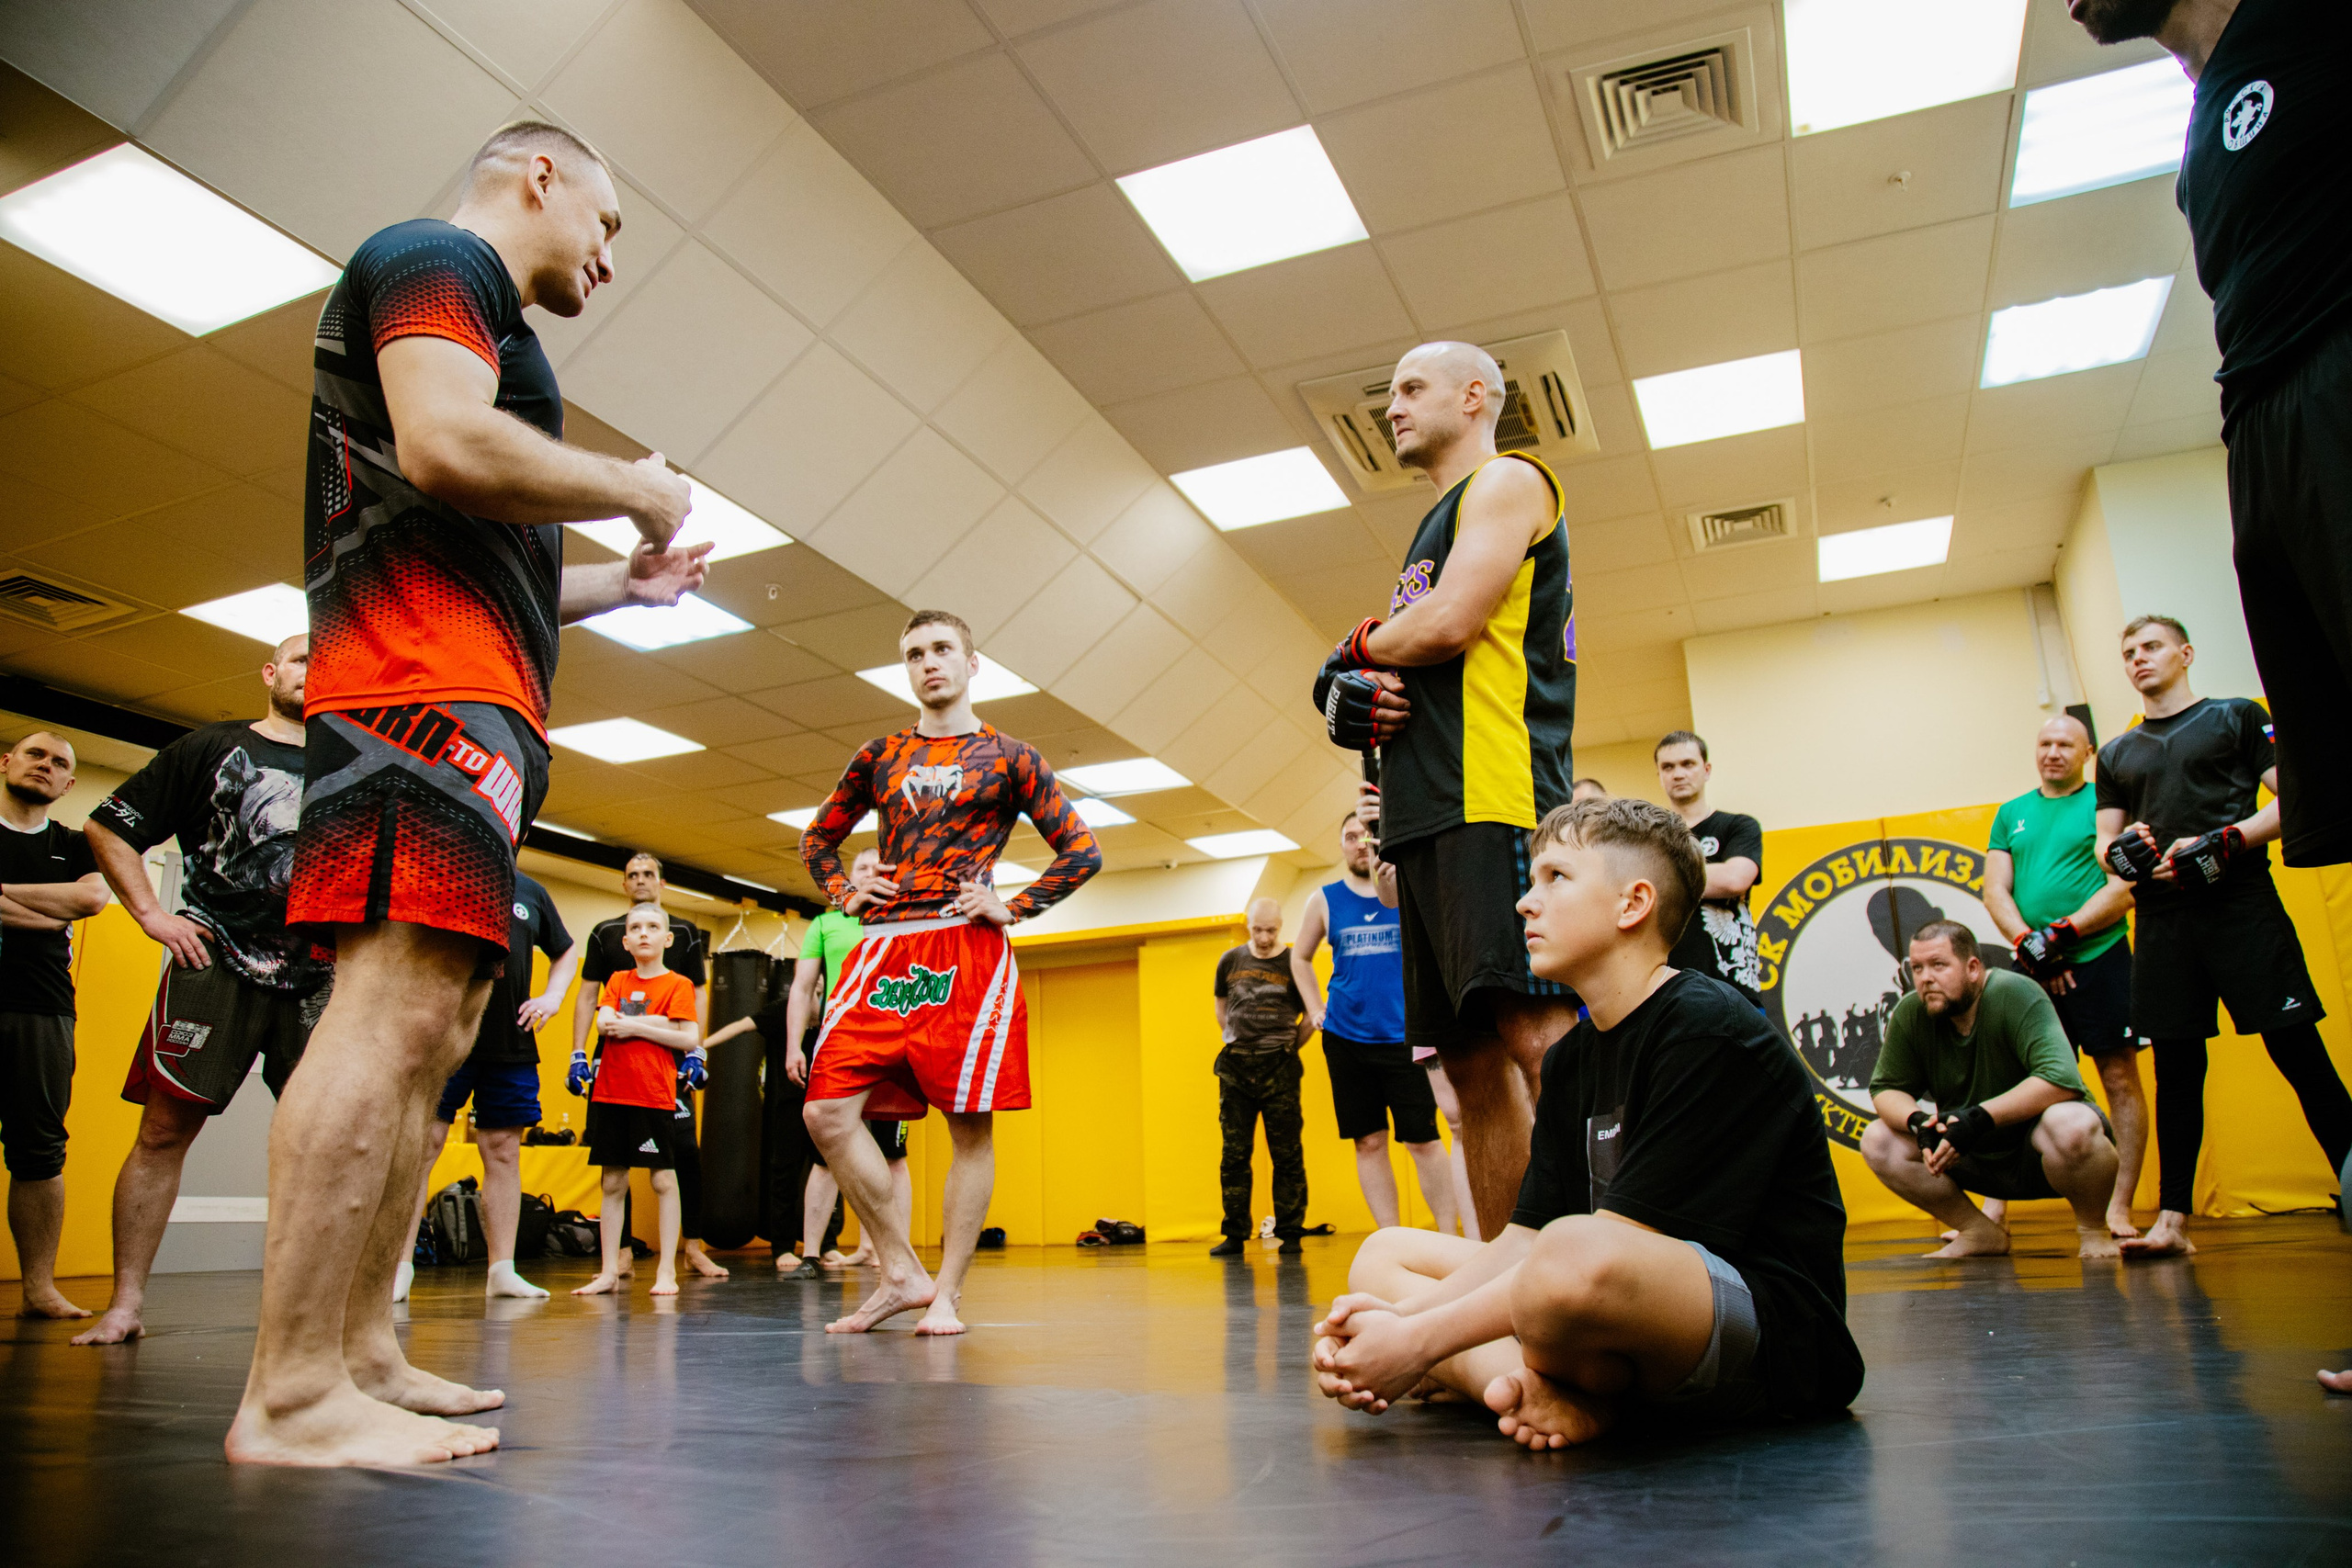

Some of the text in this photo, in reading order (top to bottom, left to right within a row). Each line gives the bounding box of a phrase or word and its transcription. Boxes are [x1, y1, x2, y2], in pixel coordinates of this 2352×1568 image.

[453, 740, 488, 771] TO
[2110, 845, 2138, 875] FIGHT
[1346, 931, 1394, 945] PLATINUM
